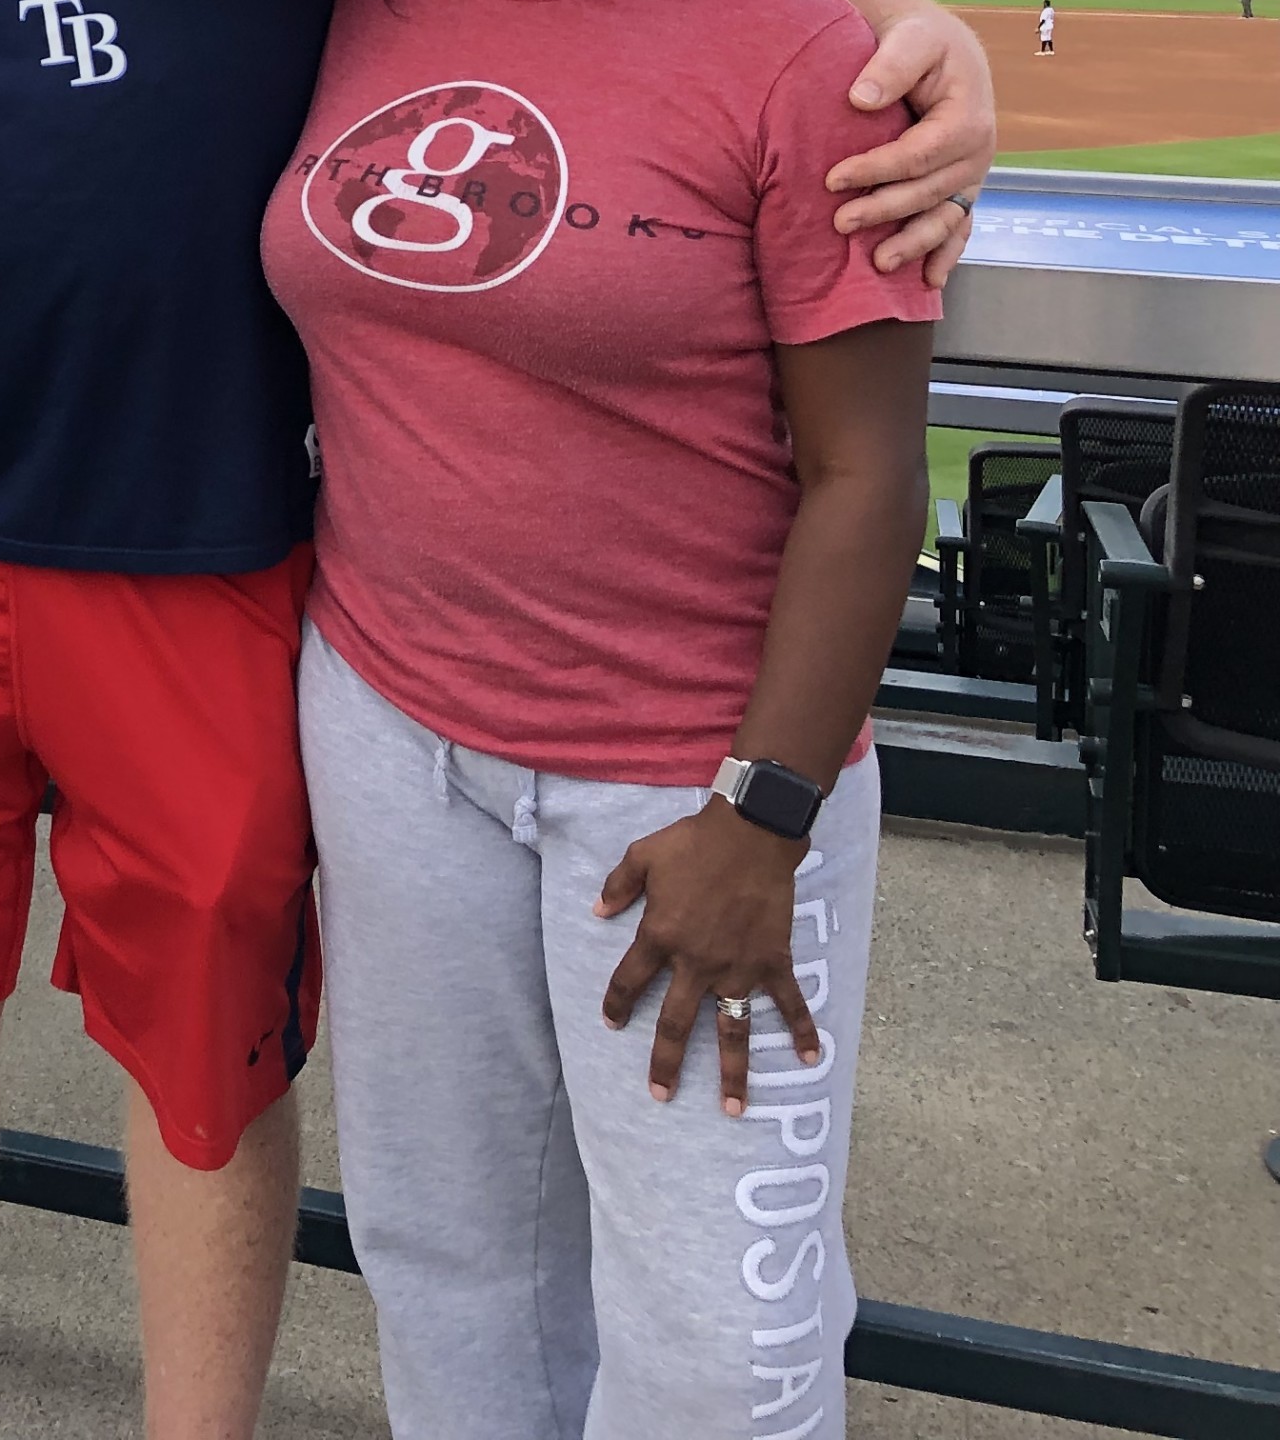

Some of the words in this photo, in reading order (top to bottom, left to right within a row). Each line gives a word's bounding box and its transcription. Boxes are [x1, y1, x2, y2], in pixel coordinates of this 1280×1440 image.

[351, 117, 515, 252] g
[972, 223, 1104, 240] THE
[973, 215, 1216, 238] OFFICIAL
[1237, 230, 1280, 241] S
